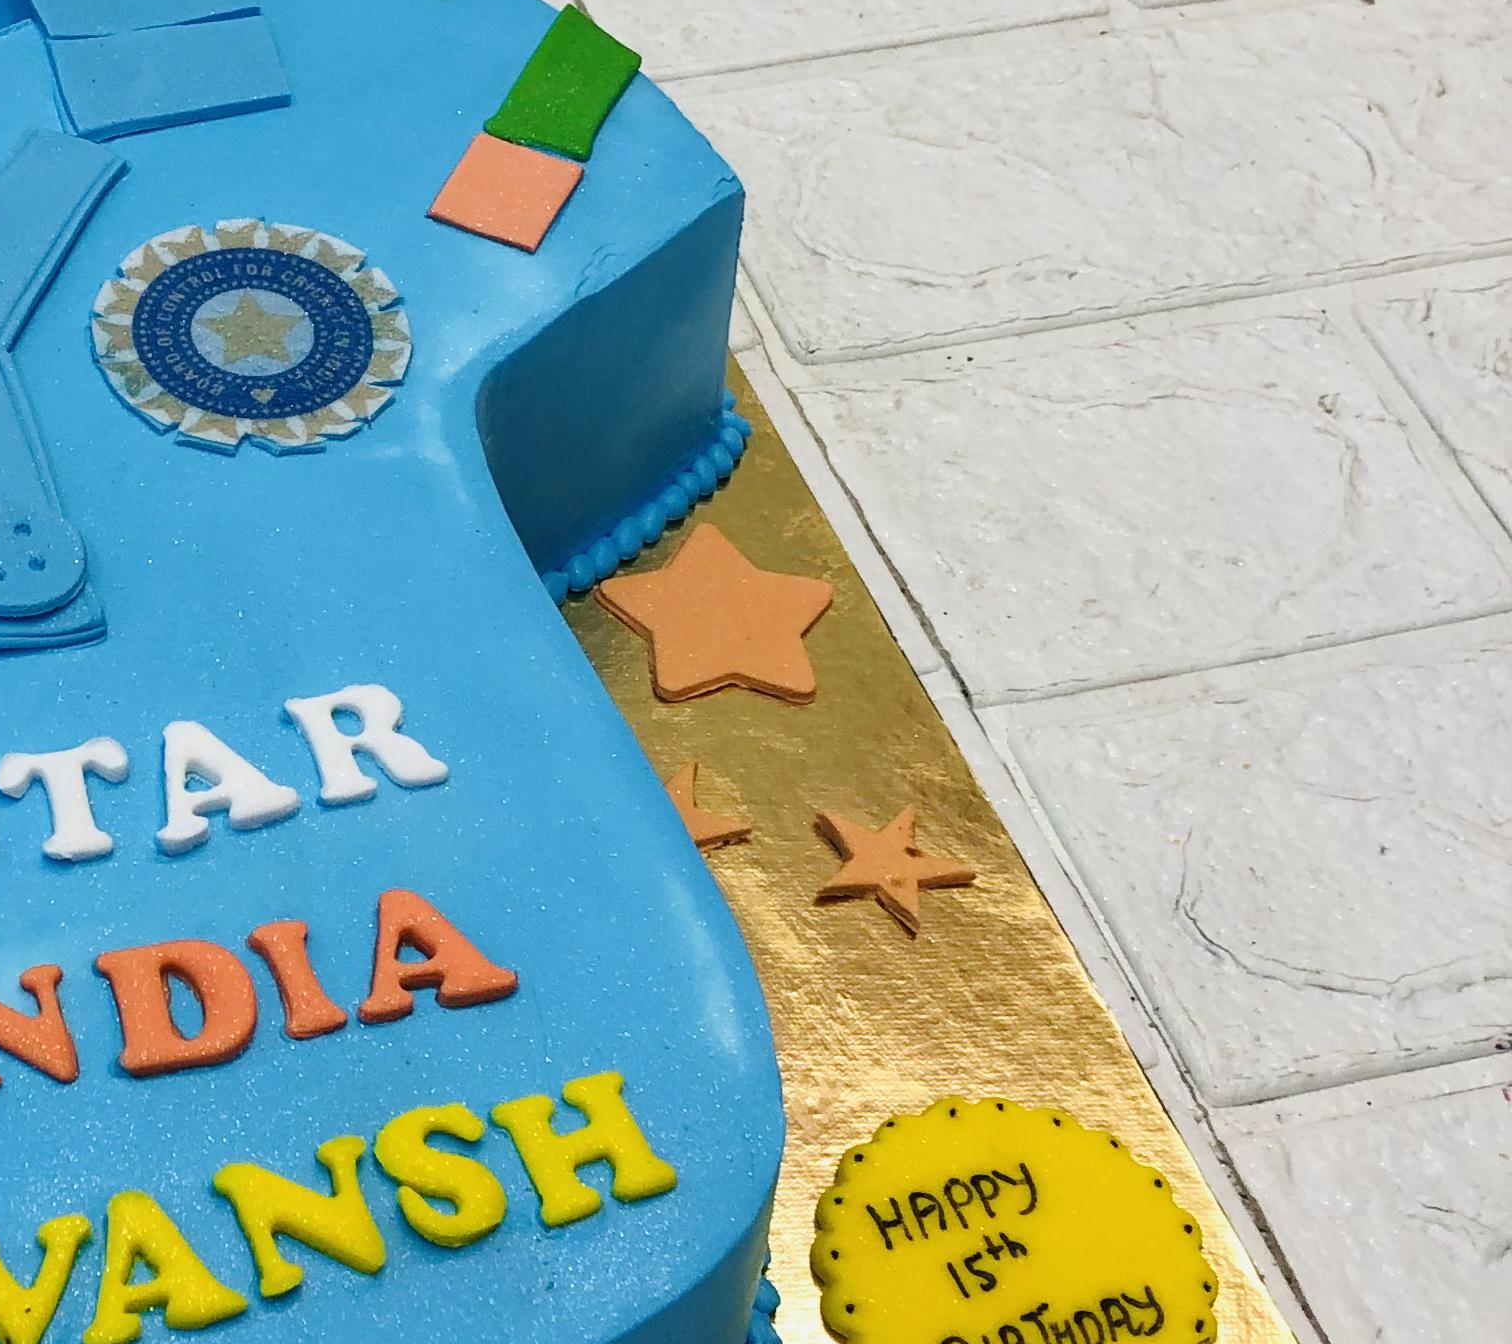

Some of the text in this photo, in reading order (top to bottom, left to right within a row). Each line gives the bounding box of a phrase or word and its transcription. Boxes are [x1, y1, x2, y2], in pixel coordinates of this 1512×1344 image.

[156, 267, 225, 322] CONTROL
[233, 263, 273, 277] FOR
[165, 353, 225, 396] BOARD
[866, 1162, 1038, 1250] HAPPY
[946, 1232, 1028, 1299] 15th
